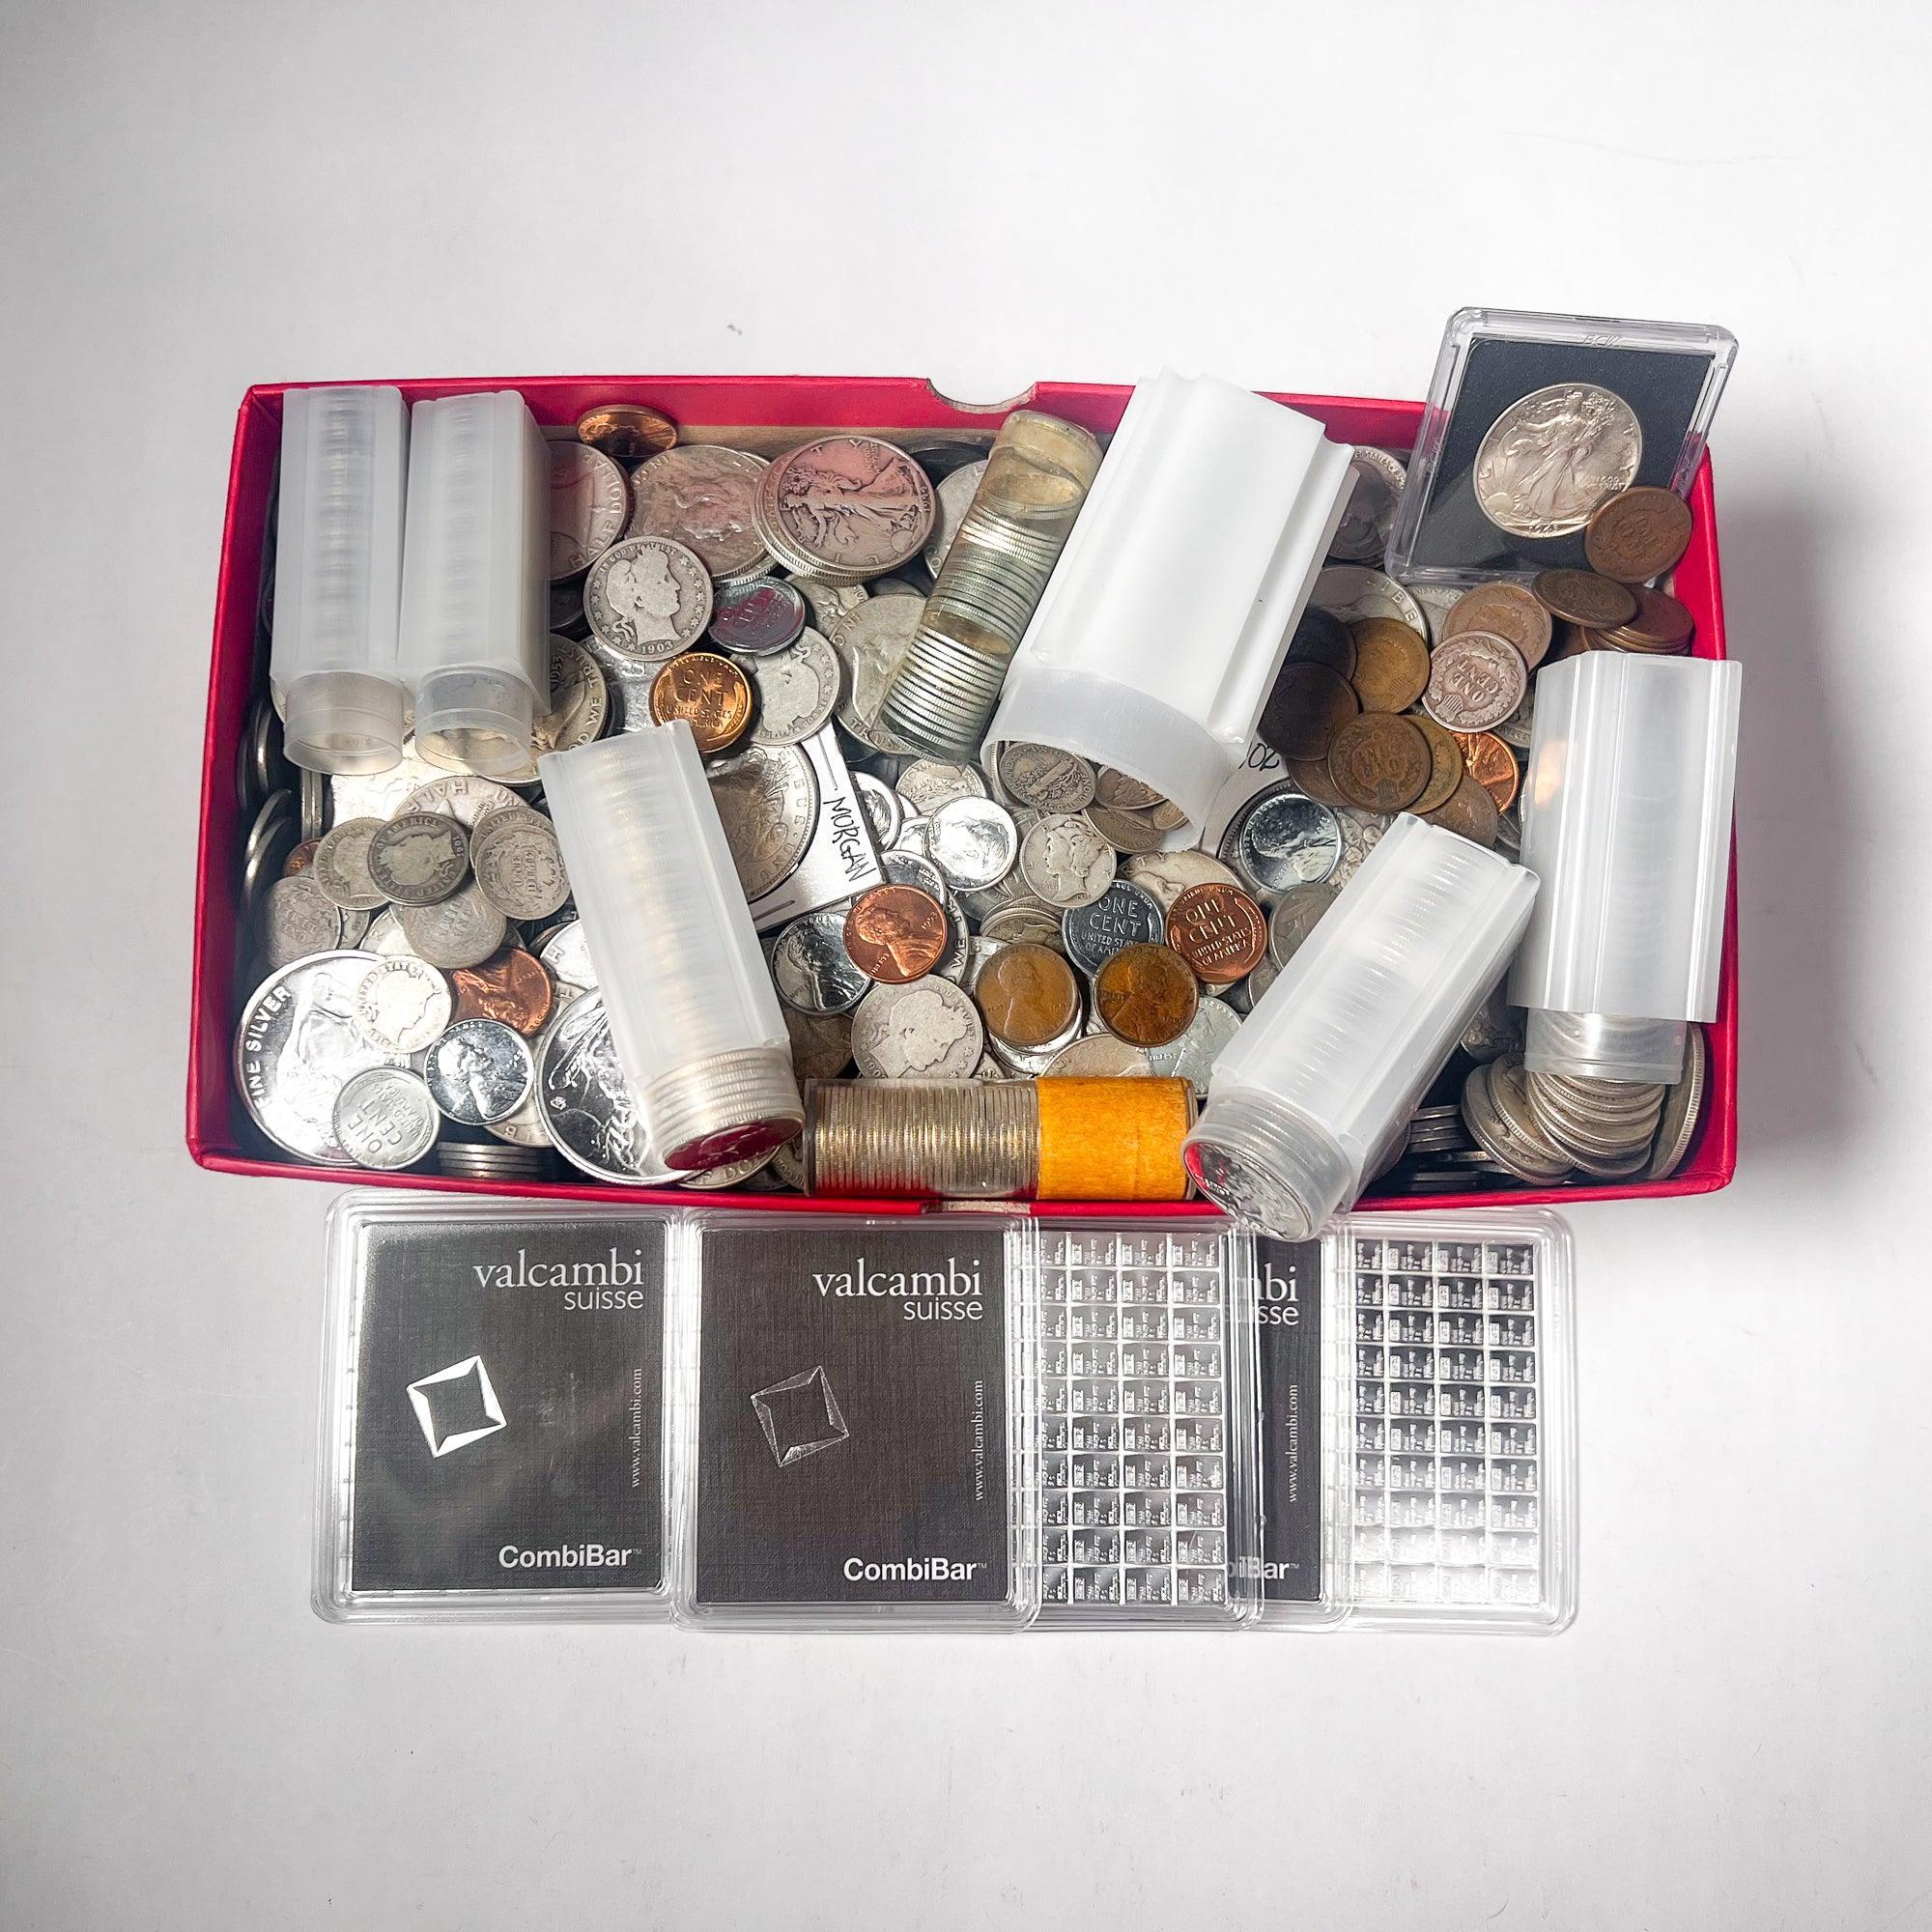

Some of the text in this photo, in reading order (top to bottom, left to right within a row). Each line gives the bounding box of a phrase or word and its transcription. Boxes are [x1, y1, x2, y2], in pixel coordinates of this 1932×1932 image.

[640, 639, 674, 655] 1903
[684, 668, 724, 688] ONE
[1450, 673, 1487, 703] ONE
[1456, 658, 1500, 696] CENT
[586, 696, 603, 726] WE
[673, 687, 728, 706] CENT
[822, 796, 878, 882] MORGAN
[1089, 912, 1142, 937] CENT
[1098, 895, 1138, 918] ONE
[245, 984, 293, 1053] SILVER
[348, 1113, 383, 1154] ONE
[356, 1099, 403, 1146] CENT
[472, 1247, 644, 1288] valcambi
[812, 1258, 982, 1297] valcambi
[564, 1287, 643, 1310] suisse
[903, 1297, 982, 1320] suisse
[629, 1368, 642, 1489] www.valcambi.com
[971, 1379, 983, 1501] www.valcambi.com
[1285, 1384, 1298, 1503] www.valcambi.com
